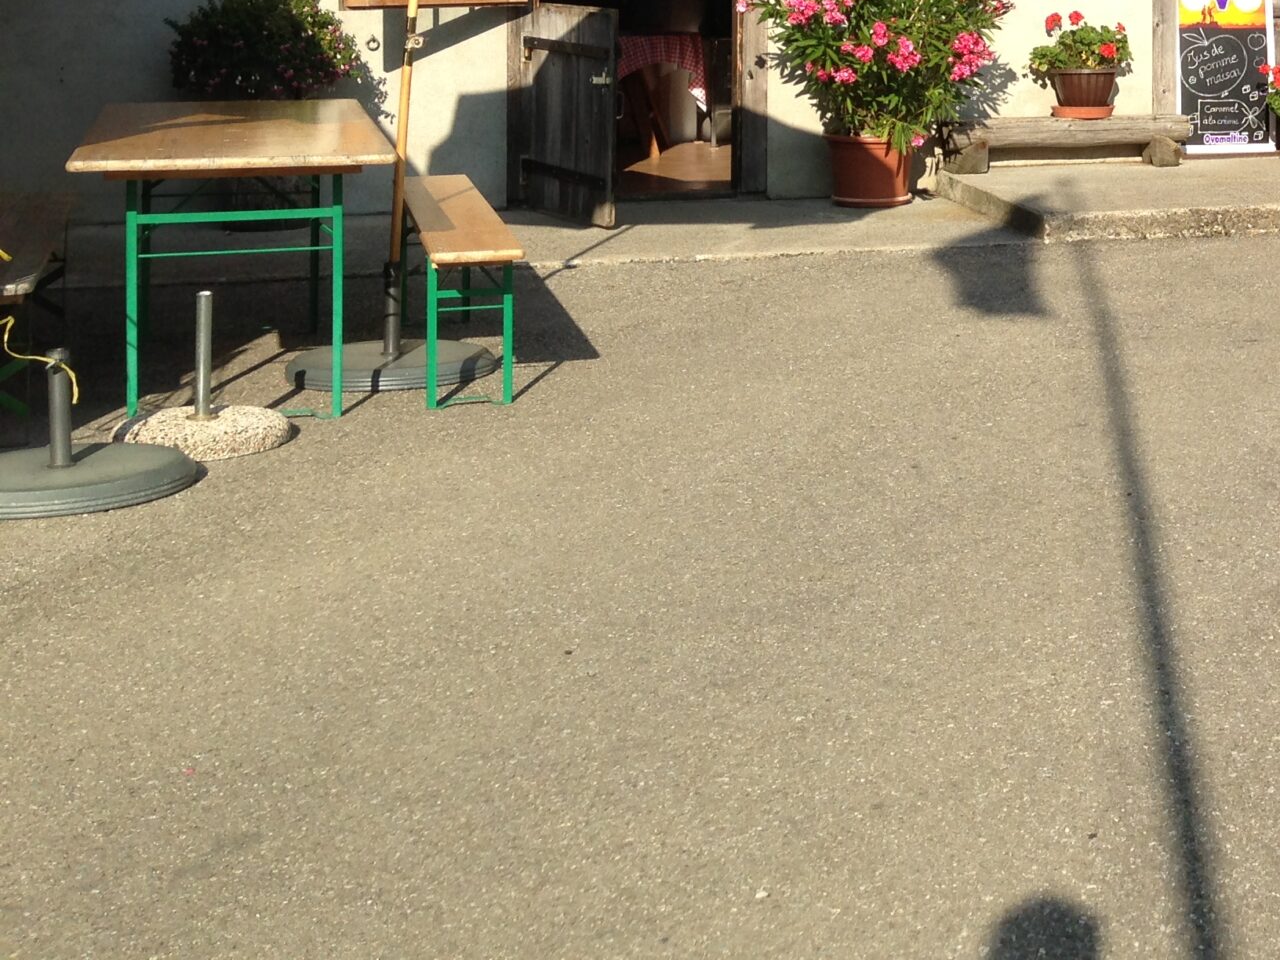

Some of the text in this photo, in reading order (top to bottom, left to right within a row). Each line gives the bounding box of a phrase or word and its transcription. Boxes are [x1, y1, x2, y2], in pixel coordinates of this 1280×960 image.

[1211, 43, 1225, 57] de
[1199, 54, 1239, 78] pomme
[1206, 68, 1242, 87] maison
[1204, 101, 1239, 113] Caramel
[1204, 133, 1248, 144] Ovomaltine
